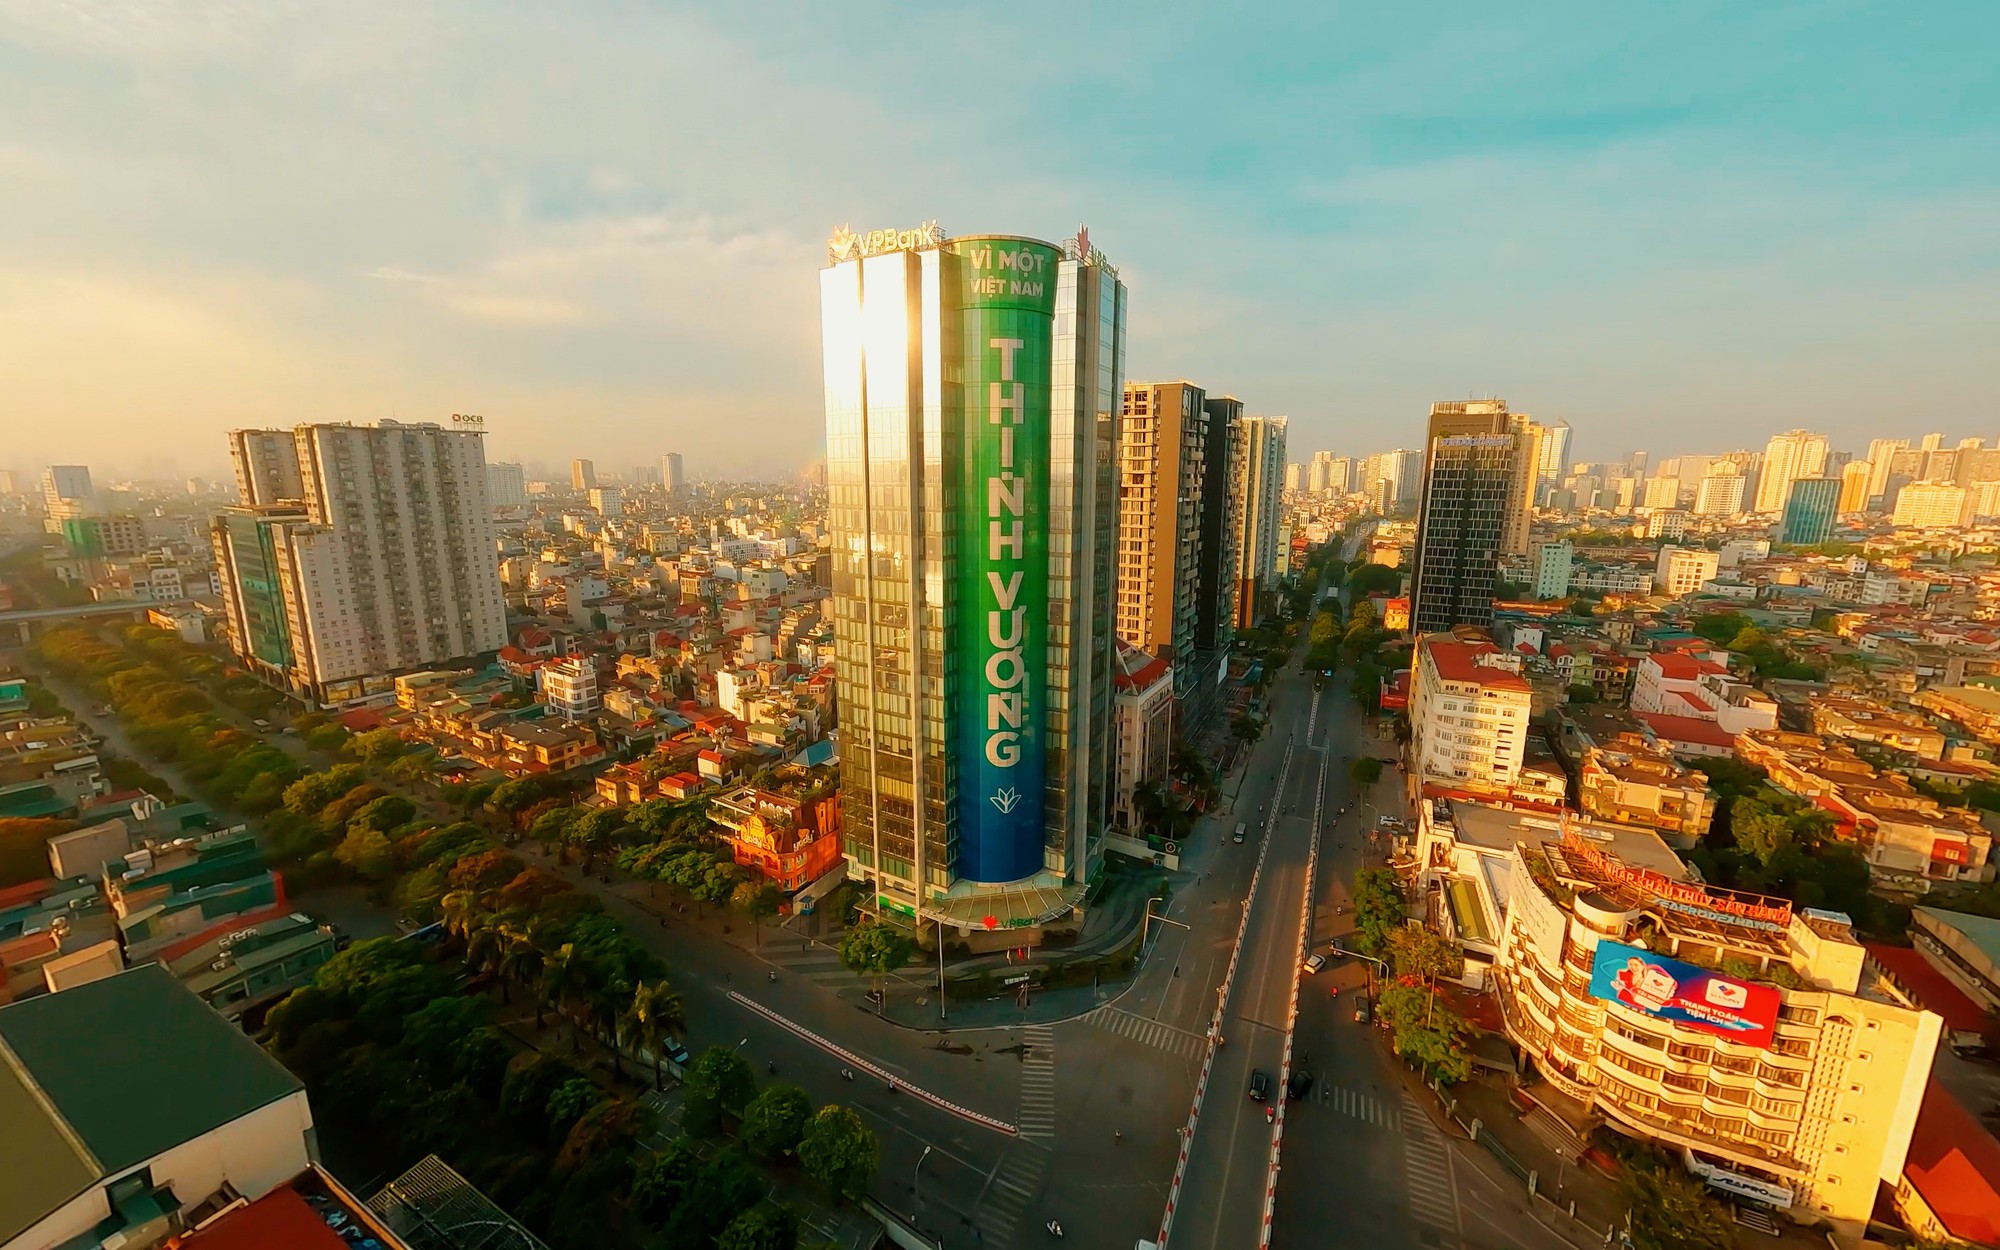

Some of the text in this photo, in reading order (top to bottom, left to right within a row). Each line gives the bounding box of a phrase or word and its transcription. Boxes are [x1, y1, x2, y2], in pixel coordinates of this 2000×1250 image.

[857, 219, 937, 256] VPBank
[970, 244, 1045, 278] VÌ MỘT
[970, 275, 1044, 298] VIỆT NAM
[462, 414, 484, 423] OCB
[985, 338, 1028, 768] THỊNH VƯỢNG
[1680, 999, 1740, 1022] THANH TOÁN
[1685, 1008, 1706, 1019] TIỆN
